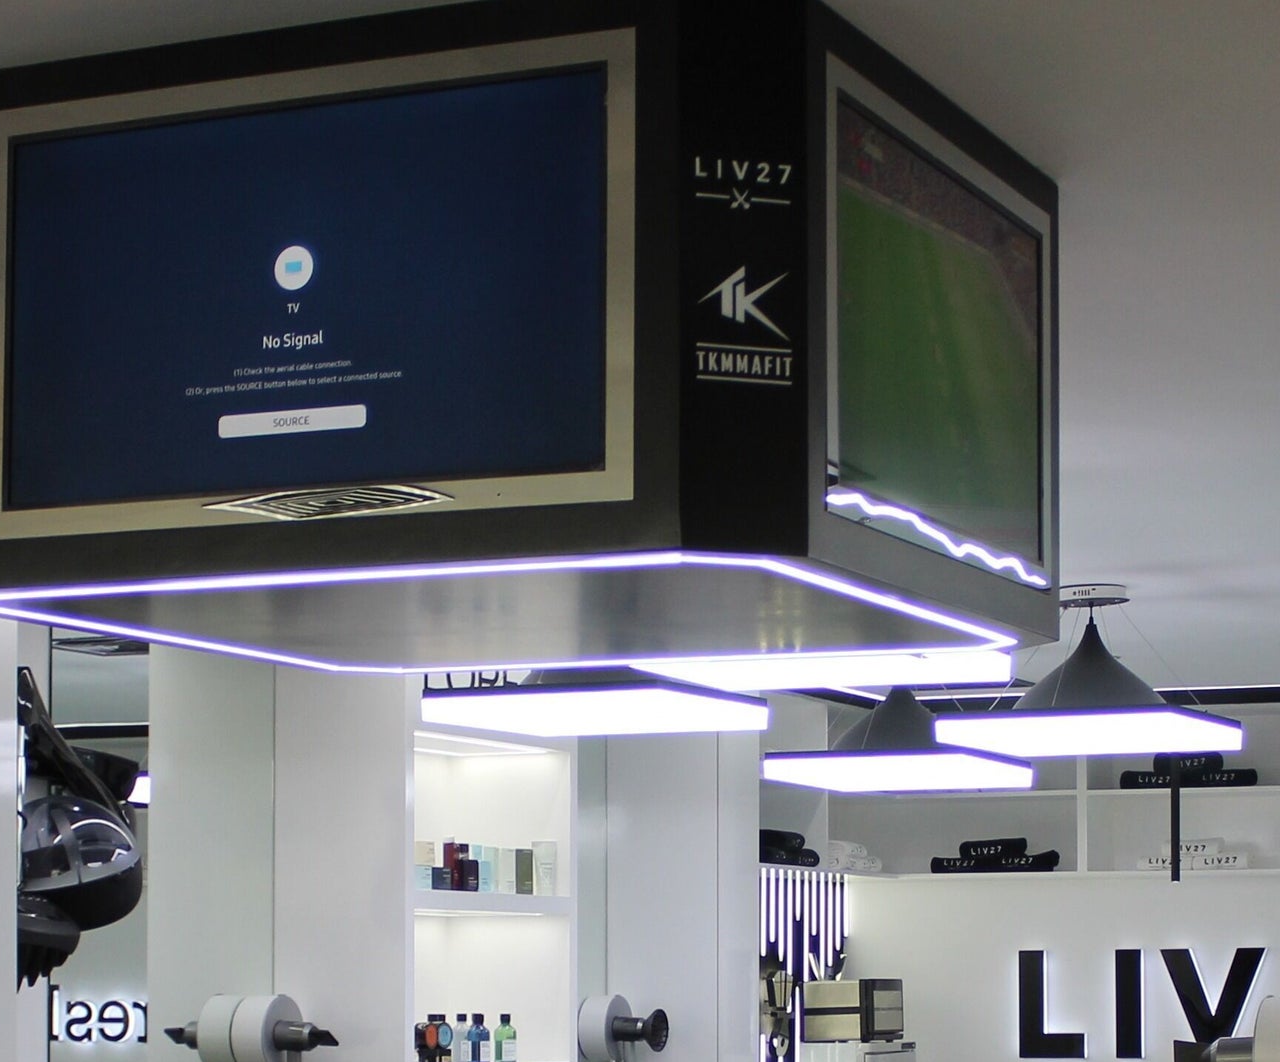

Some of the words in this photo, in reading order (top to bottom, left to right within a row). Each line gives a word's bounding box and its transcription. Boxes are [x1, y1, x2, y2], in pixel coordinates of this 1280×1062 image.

[695, 156, 792, 185] LIV27
[286, 302, 300, 314] TV
[262, 334, 281, 349] No
[283, 329, 323, 350] Signal
[243, 367, 263, 376] Check
[264, 366, 276, 374] the
[276, 364, 295, 373] aerial
[296, 362, 314, 371] cable
[696, 351, 793, 377] TKMMAFIT
[205, 386, 223, 395] press
[224, 384, 235, 392] the
[236, 381, 263, 391] SOURCE
[263, 380, 286, 389] button
[287, 378, 307, 387] below
[308, 377, 316, 385] to
[316, 376, 337, 384] select
[343, 372, 378, 382] connected
[272, 415, 310, 428] SOURCE
[1180, 757, 1206, 767] IV27
[970, 845, 1002, 856] LIV27
[1180, 844, 1207, 852] IV27
[1203, 856, 1238, 865] LIV27
